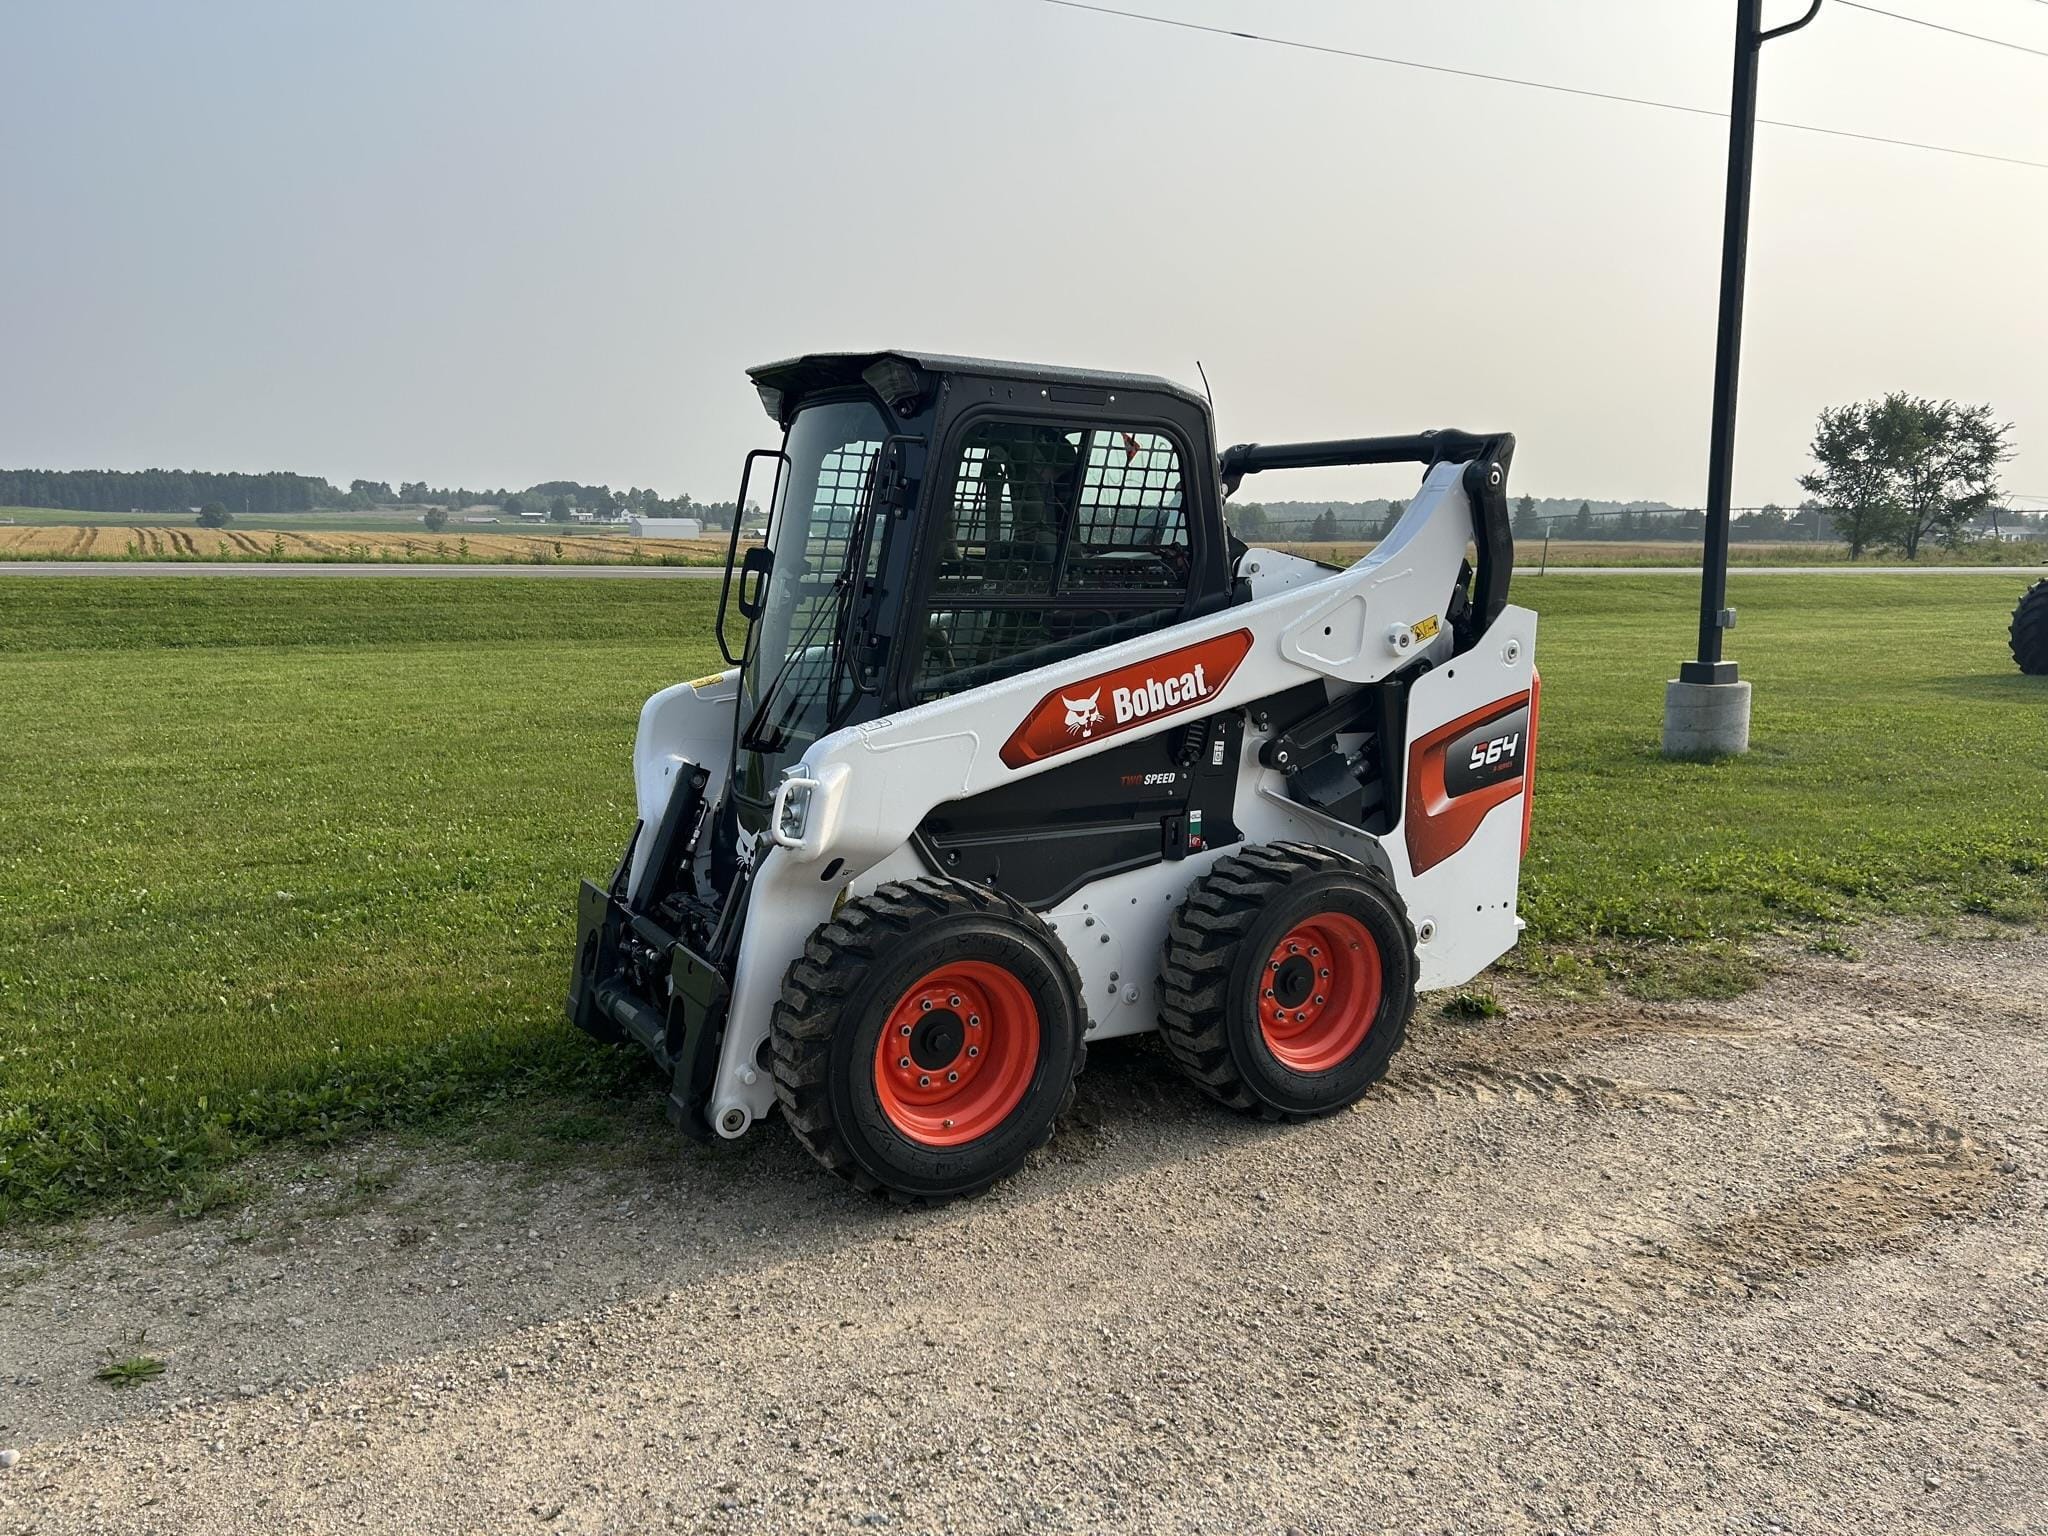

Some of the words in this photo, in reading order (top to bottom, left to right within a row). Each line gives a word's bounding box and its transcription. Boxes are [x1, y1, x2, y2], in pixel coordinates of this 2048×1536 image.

[1112, 664, 1207, 724] Bobcat
[1469, 733, 1519, 770] S64
[1120, 774, 1143, 785] TWO
[1143, 772, 1176, 785] SPEED
